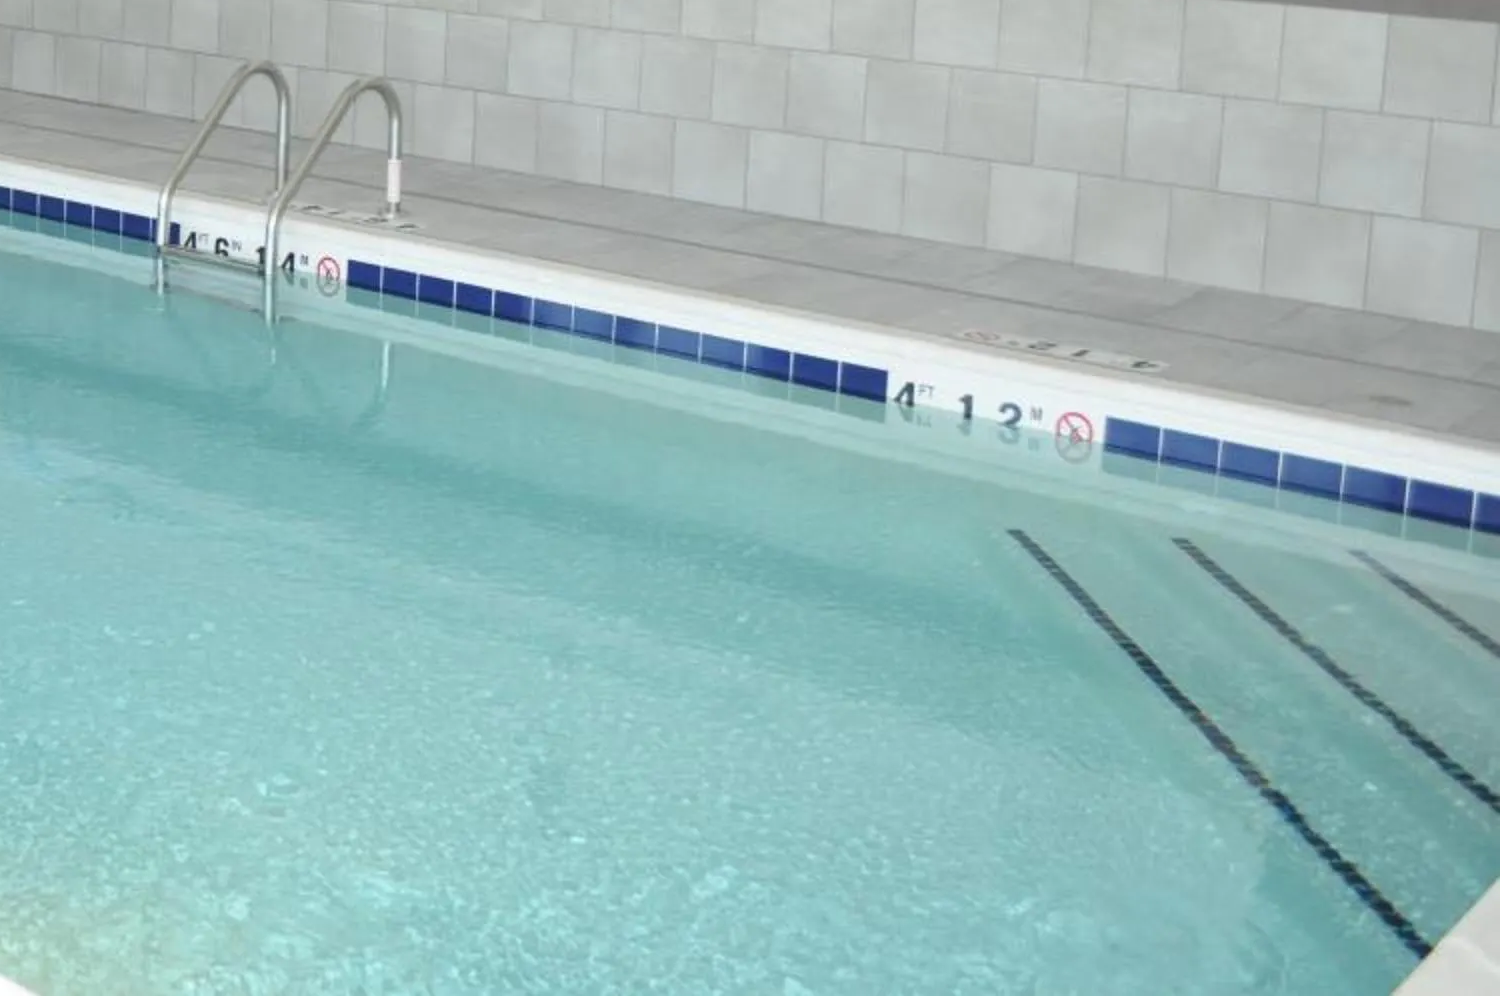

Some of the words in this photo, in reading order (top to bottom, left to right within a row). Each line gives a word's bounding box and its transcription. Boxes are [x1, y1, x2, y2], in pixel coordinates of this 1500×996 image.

[214, 237, 229, 257] 6
[894, 382, 915, 407] 4
[918, 384, 935, 398] FT
[959, 394, 973, 420] 1
[998, 402, 1022, 429] 2
